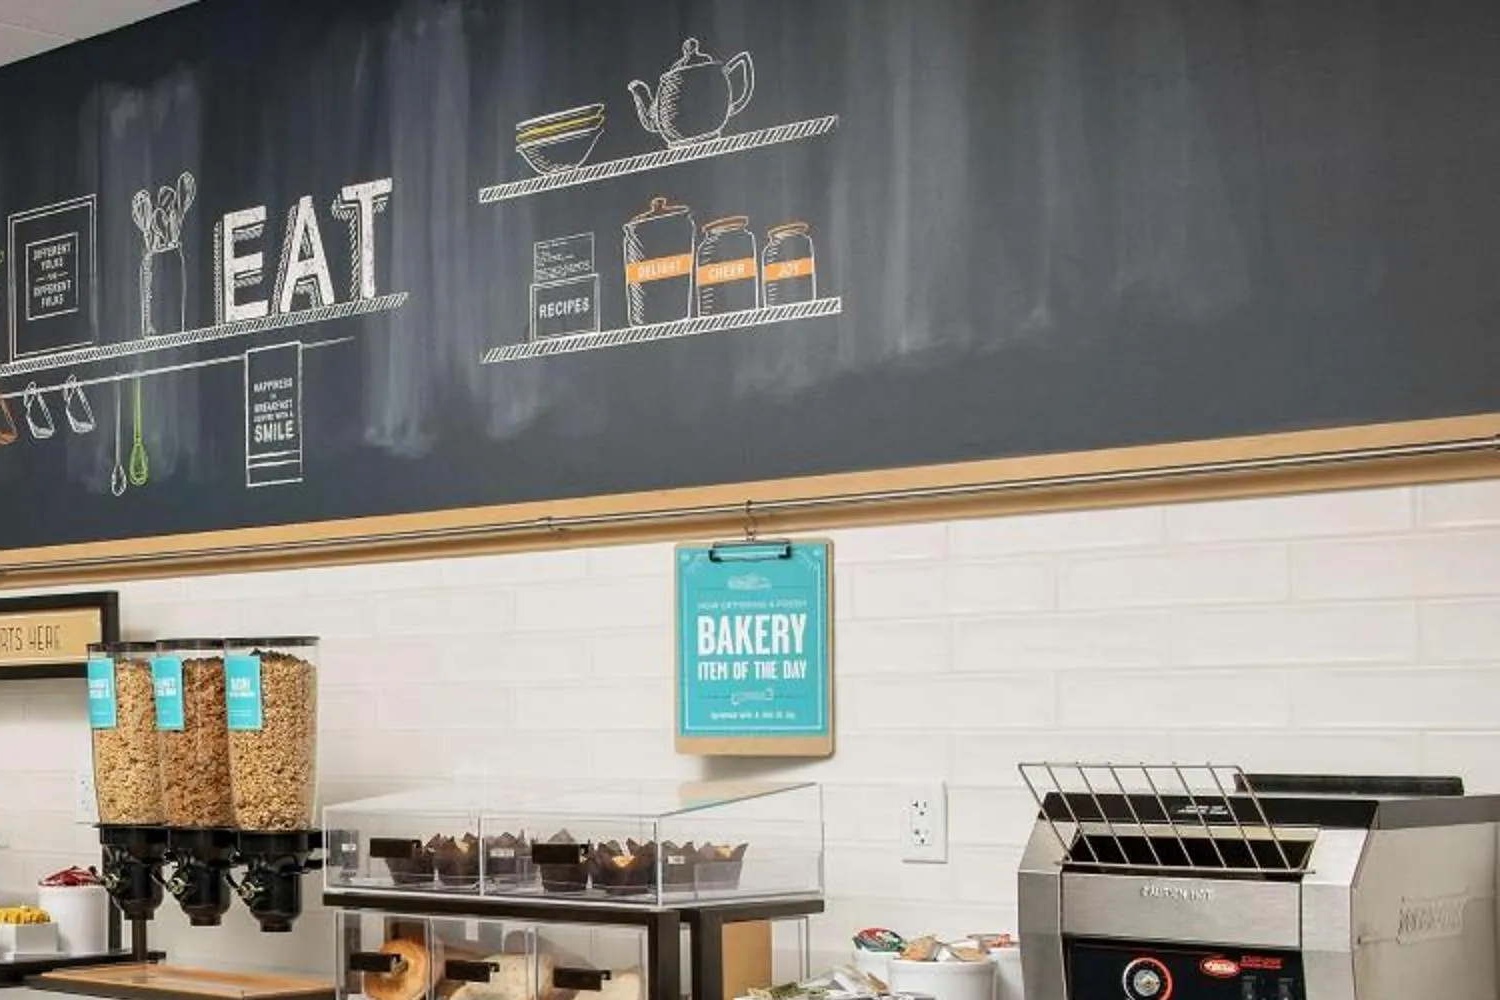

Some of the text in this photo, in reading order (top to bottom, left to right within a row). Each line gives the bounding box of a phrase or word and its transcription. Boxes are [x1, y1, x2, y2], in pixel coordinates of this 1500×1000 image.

[218, 177, 393, 323] EAT
[708, 264, 745, 278] CHEER
[539, 298, 589, 319] RECIPES
[254, 420, 294, 443] SMILE
[29, 625, 61, 650] HERE
[697, 614, 807, 656] BAKERY
[698, 660, 807, 680] ITEM OF THE DAY
